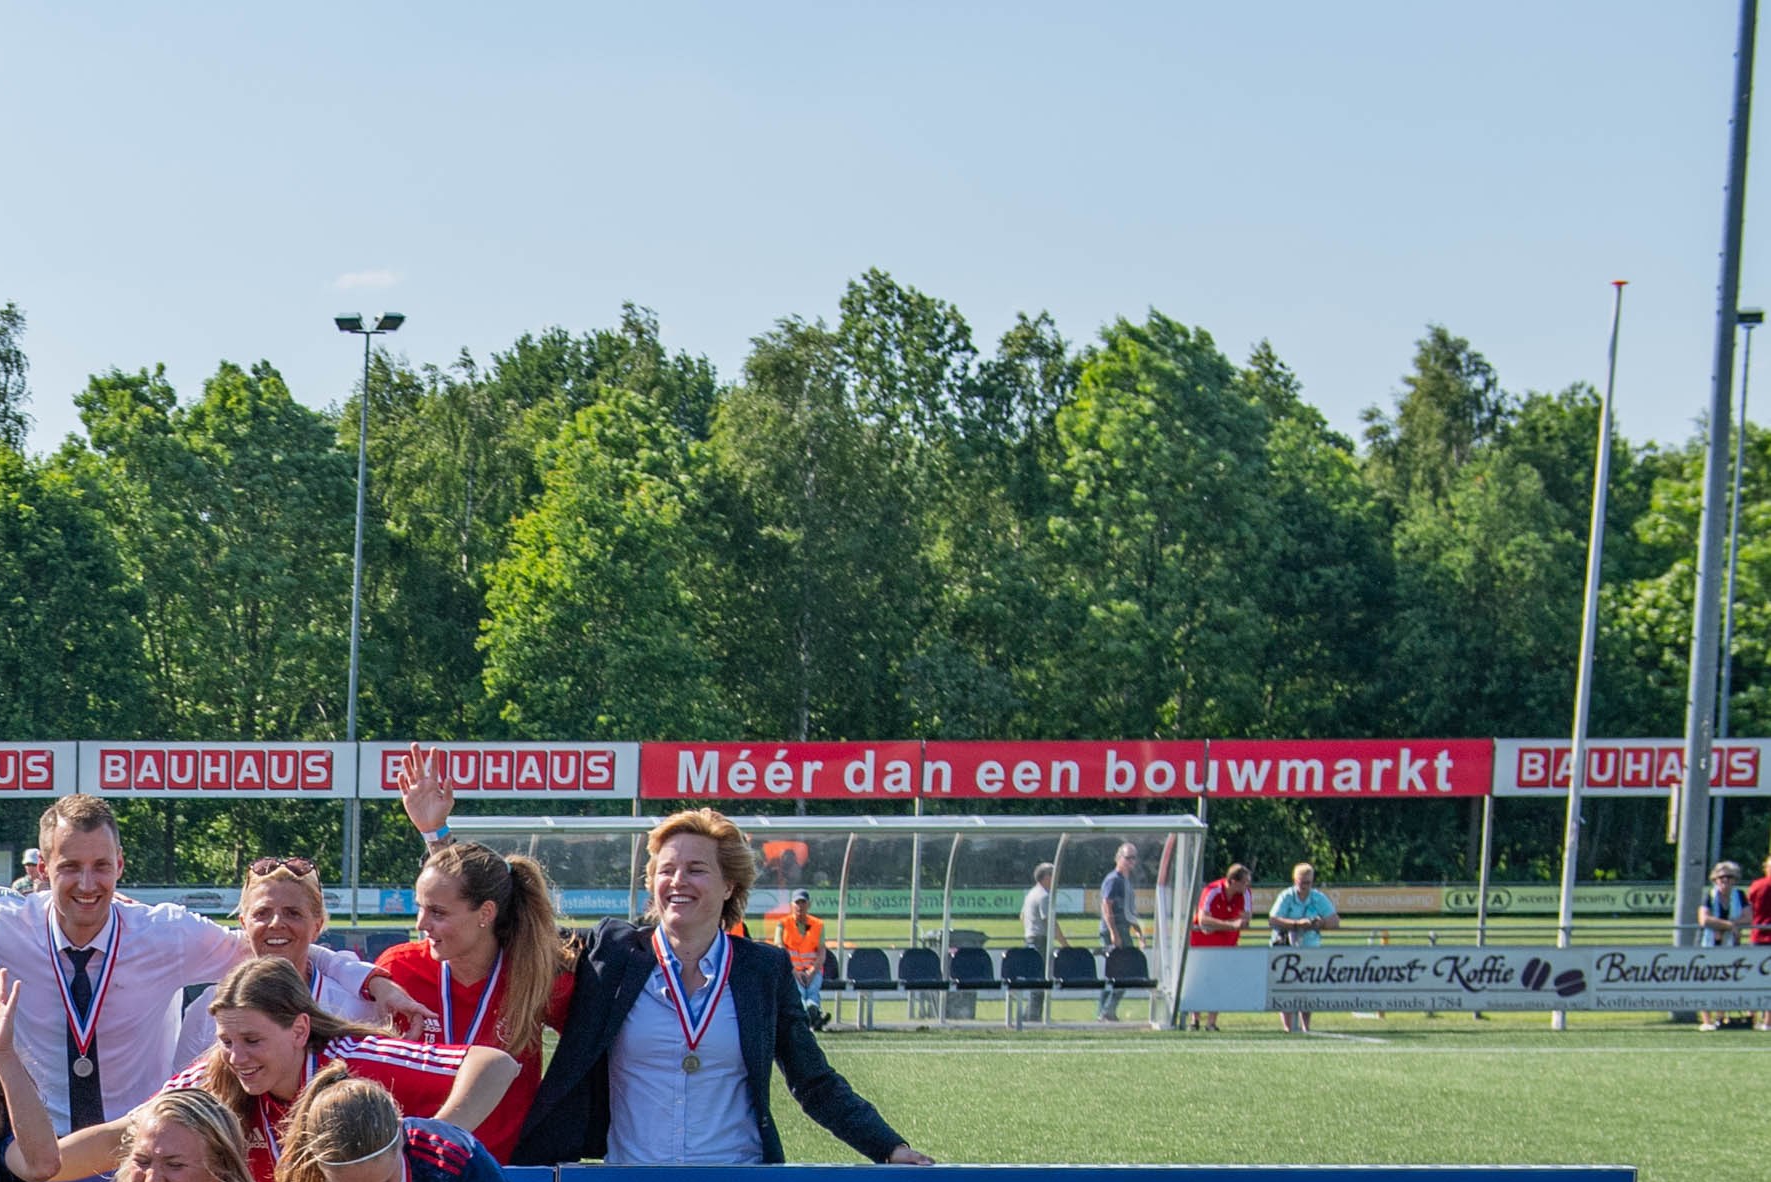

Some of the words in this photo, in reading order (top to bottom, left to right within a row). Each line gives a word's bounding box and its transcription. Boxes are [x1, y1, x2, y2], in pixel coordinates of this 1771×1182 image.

[103, 752, 330, 787] BAUHAUS
[677, 749, 823, 794] Méér
[844, 749, 952, 794] dan
[975, 759, 1080, 793] een
[1105, 748, 1452, 794] bouwmarkt
[1270, 953, 1427, 985] Beukenhorst
[1433, 954, 1515, 994] Koffie
[1595, 952, 1753, 984] Beukenhorst
[1271, 996, 1384, 1010] Koffiebranders
[1386, 996, 1427, 1010] sinds
[1431, 996, 1463, 1010] 1784
[1596, 995, 1708, 1009] Koffiebranders
